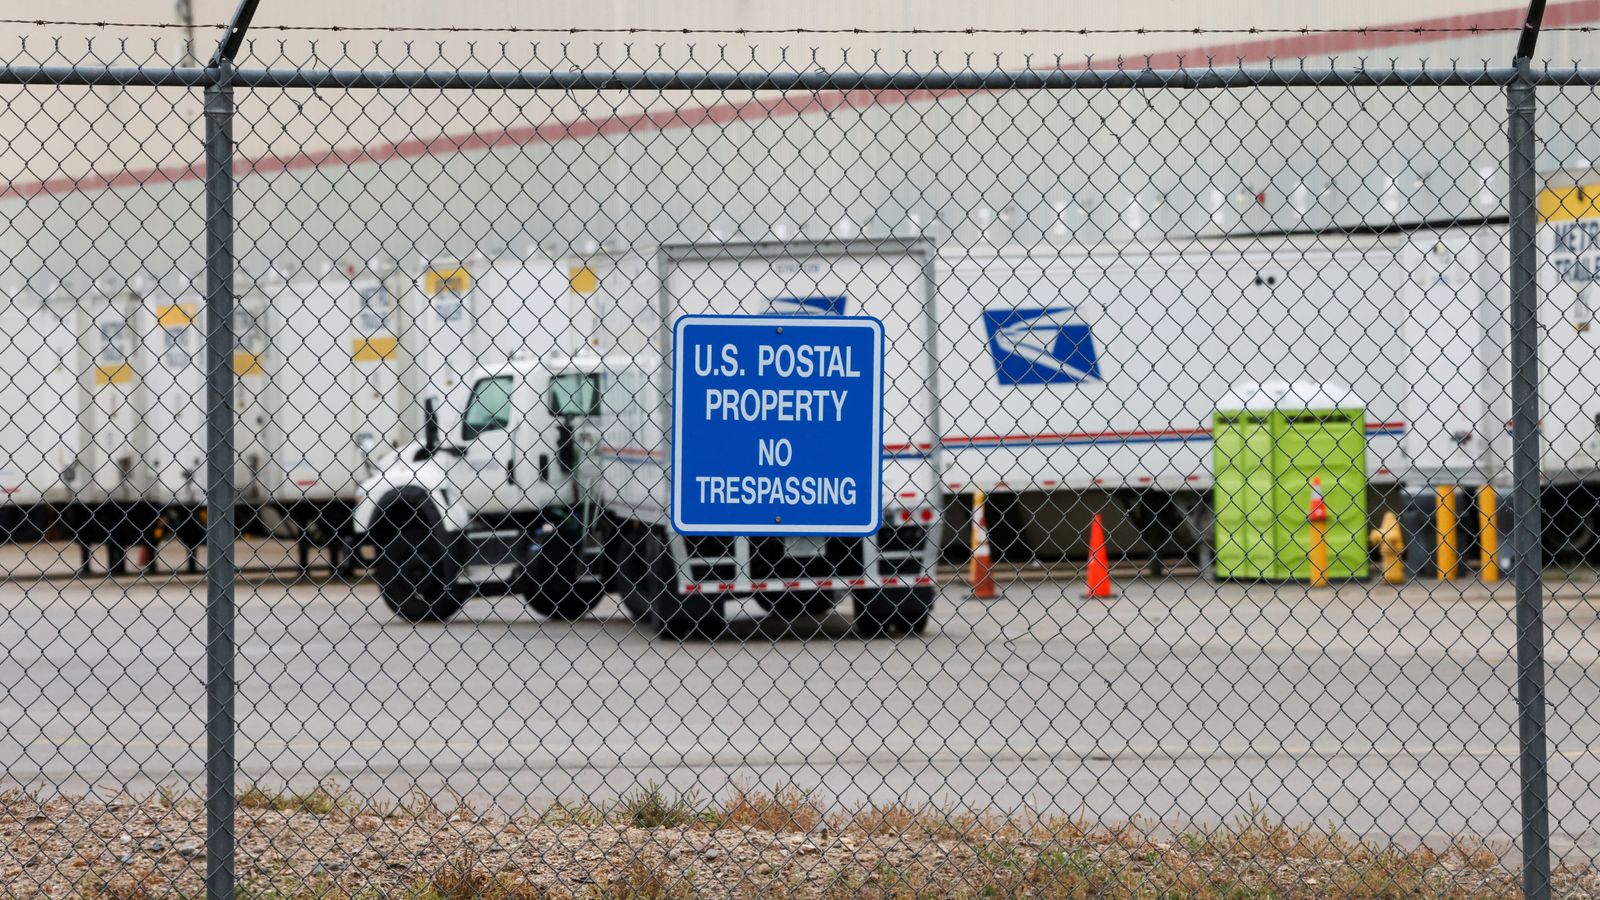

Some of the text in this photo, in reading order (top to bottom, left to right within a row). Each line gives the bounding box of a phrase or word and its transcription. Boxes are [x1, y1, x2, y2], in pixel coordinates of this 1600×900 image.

[694, 344, 861, 377] U.S. POSTAL
[705, 389, 848, 422] PROPERTY
[758, 438, 793, 467] NO
[696, 476, 857, 505] TRESPASSING
